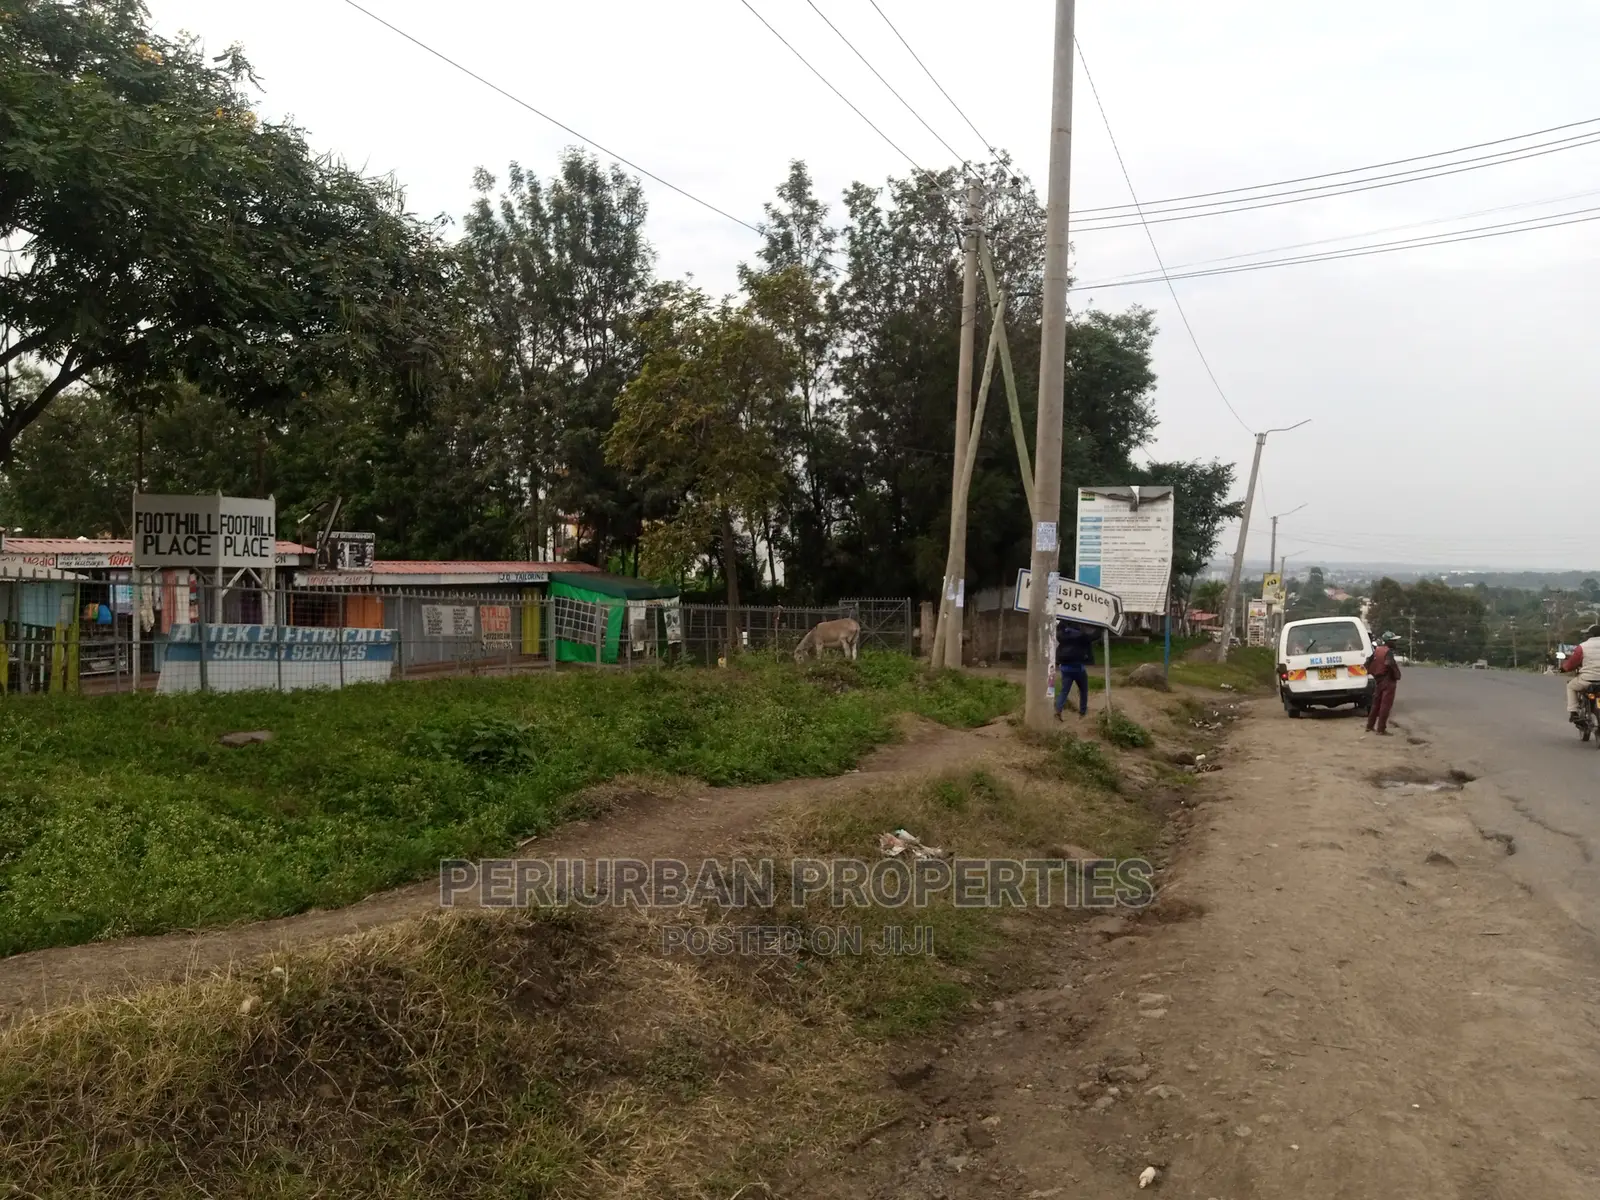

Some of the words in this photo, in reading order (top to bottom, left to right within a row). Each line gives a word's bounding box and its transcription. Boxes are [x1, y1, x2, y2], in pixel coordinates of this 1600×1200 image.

[135, 512, 218, 534] FOOTHILL
[220, 514, 274, 536] FOOTHILL
[143, 535, 211, 555] PLACE
[224, 536, 269, 557] PLACE
[1075, 588, 1110, 607] Police
[212, 644, 271, 660] SALES
[291, 645, 367, 660] SERVICES
